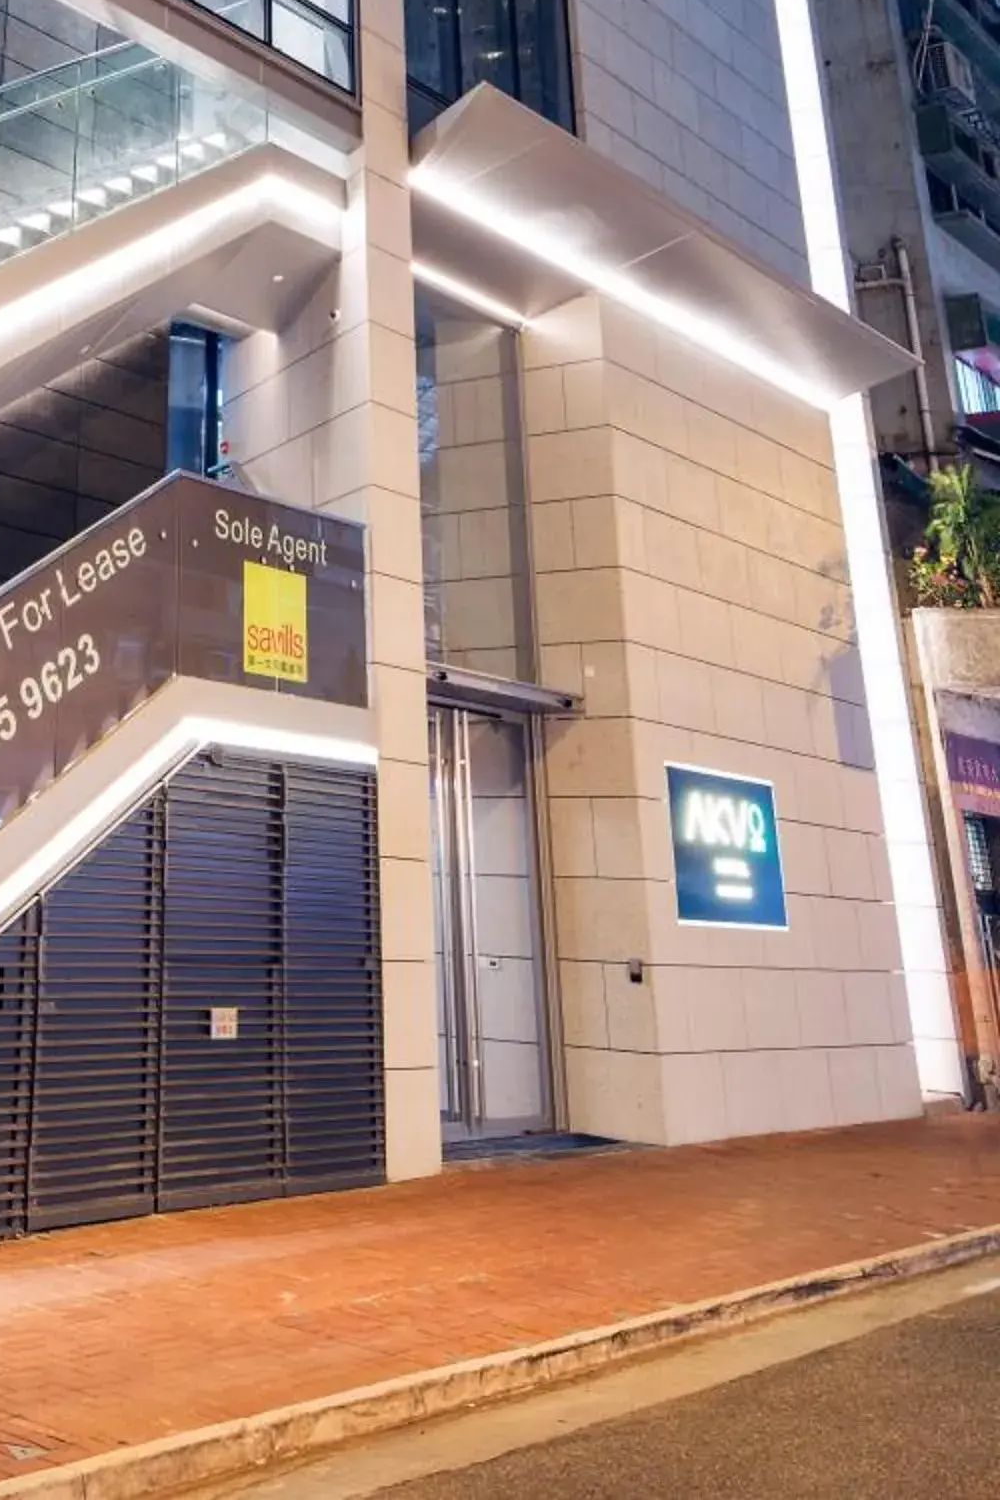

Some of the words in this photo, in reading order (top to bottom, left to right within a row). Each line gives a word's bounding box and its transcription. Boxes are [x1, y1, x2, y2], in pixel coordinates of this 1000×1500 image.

[56, 526, 147, 608] Lease
[215, 508, 263, 549] Sole
[267, 523, 328, 567] Agent
[19, 632, 101, 719] 9623
[247, 624, 304, 659] savills
